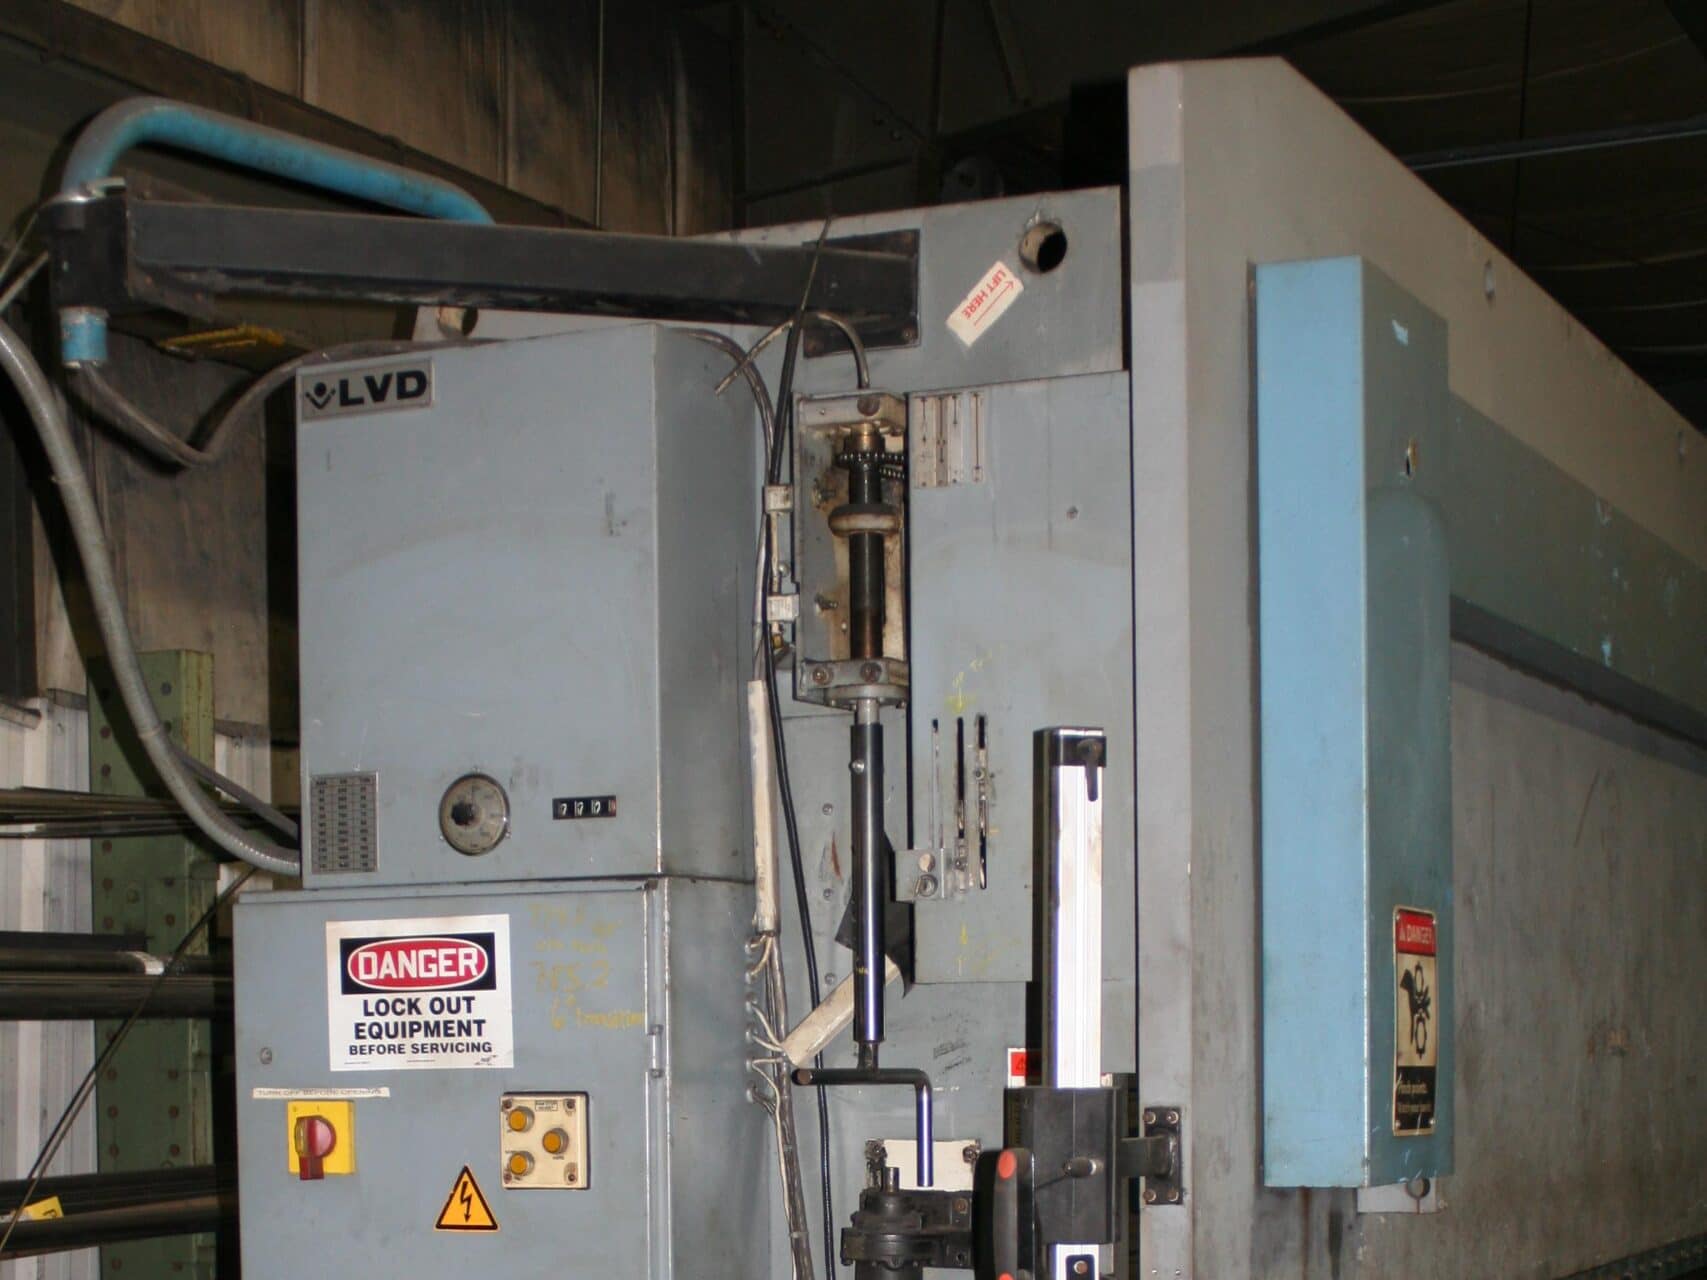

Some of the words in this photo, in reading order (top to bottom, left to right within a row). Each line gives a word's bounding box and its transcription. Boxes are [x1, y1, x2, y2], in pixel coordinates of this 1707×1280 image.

[986, 269, 1006, 292] LIFT
[962, 290, 988, 319] HERE
[338, 370, 428, 406] LVD
[358, 948, 479, 980] DANGER
[363, 998, 422, 1017] LOCK
[429, 996, 476, 1015] OUT
[354, 1019, 486, 1040] EQUIPMENT
[349, 1043, 406, 1056] BEFORE
[411, 1042, 492, 1055] SERVICING
